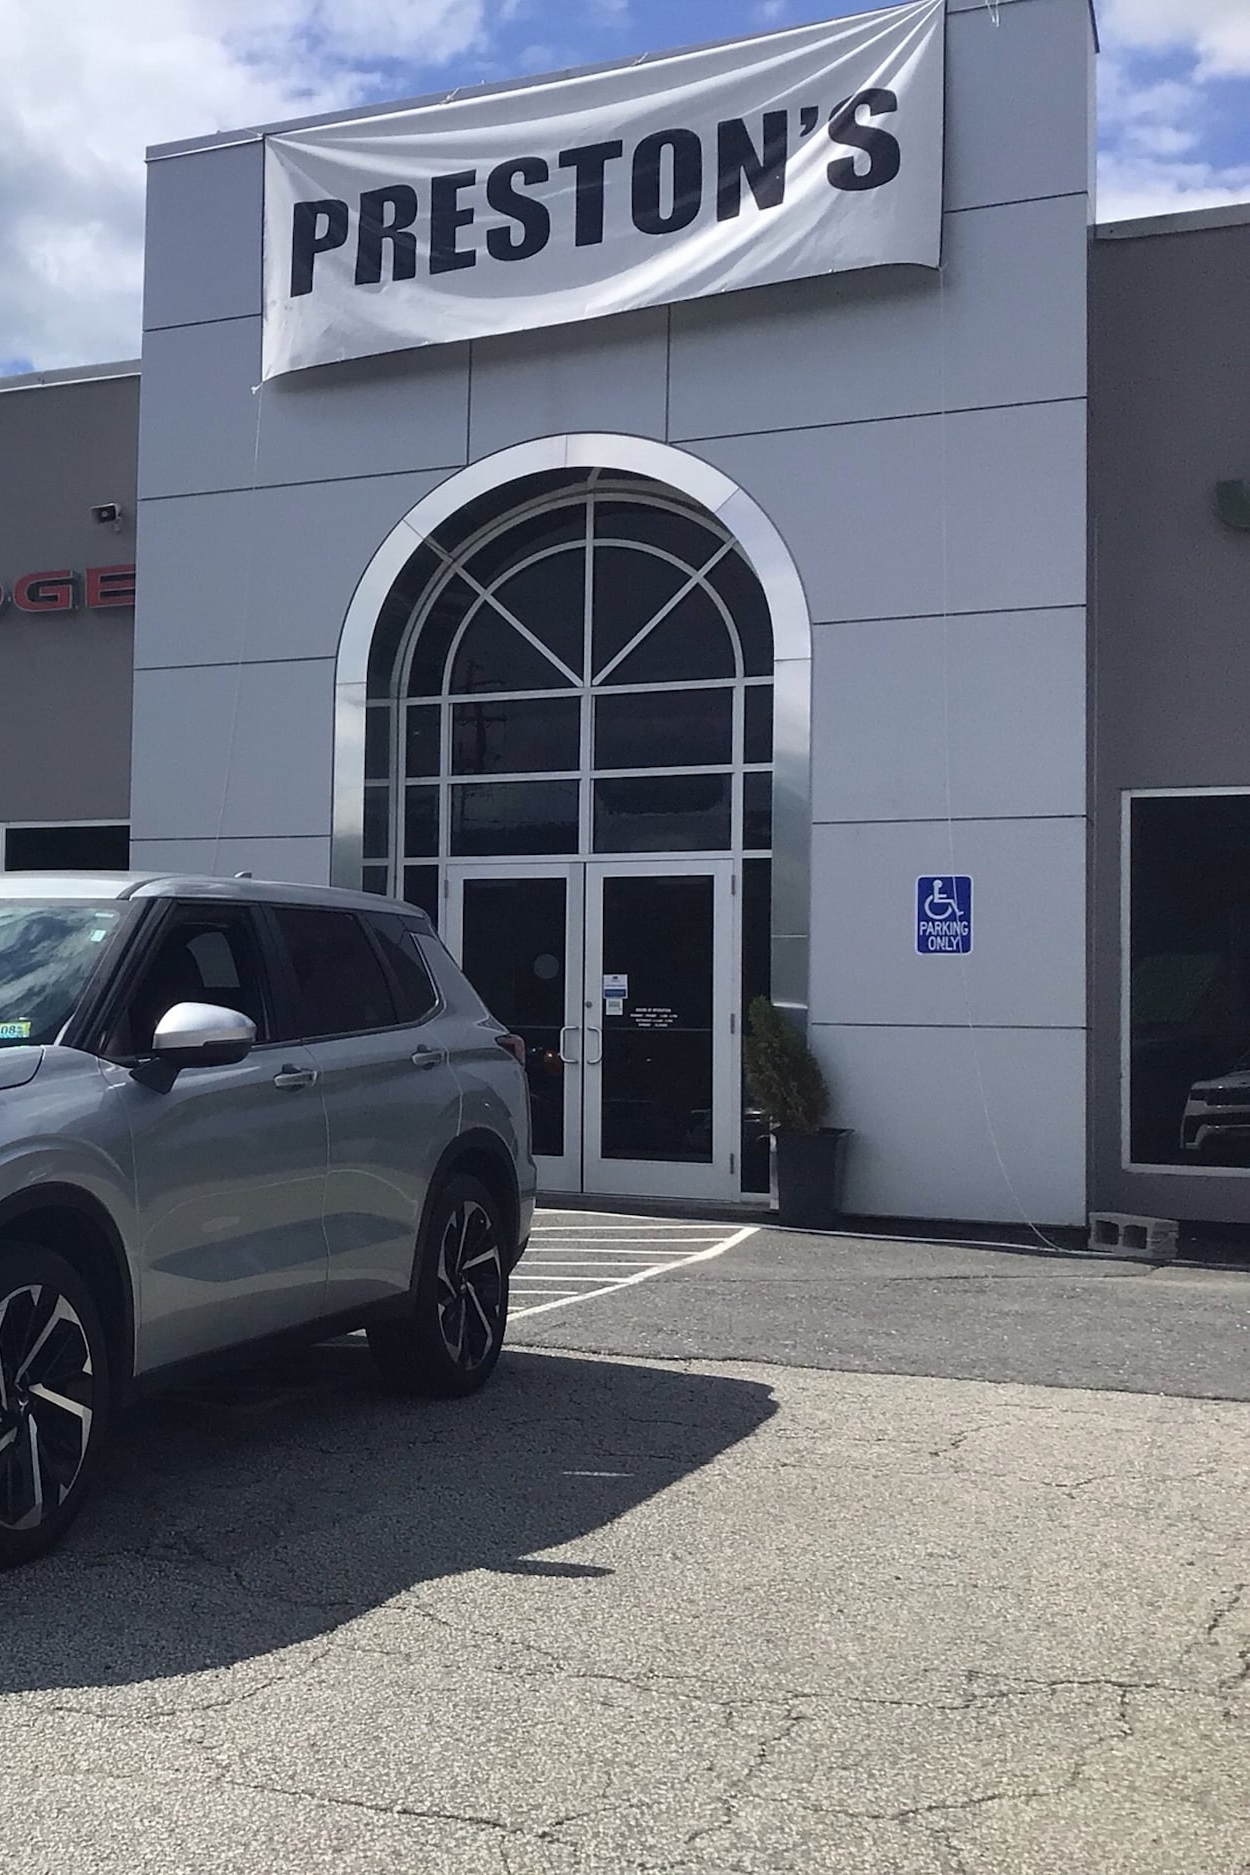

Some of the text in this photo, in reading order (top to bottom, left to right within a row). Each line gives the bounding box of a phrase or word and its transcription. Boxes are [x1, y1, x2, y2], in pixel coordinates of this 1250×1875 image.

[290, 88, 901, 298] PRESTON'S
[919, 921, 969, 936] PARKING
[928, 936, 960, 951] ONLY
